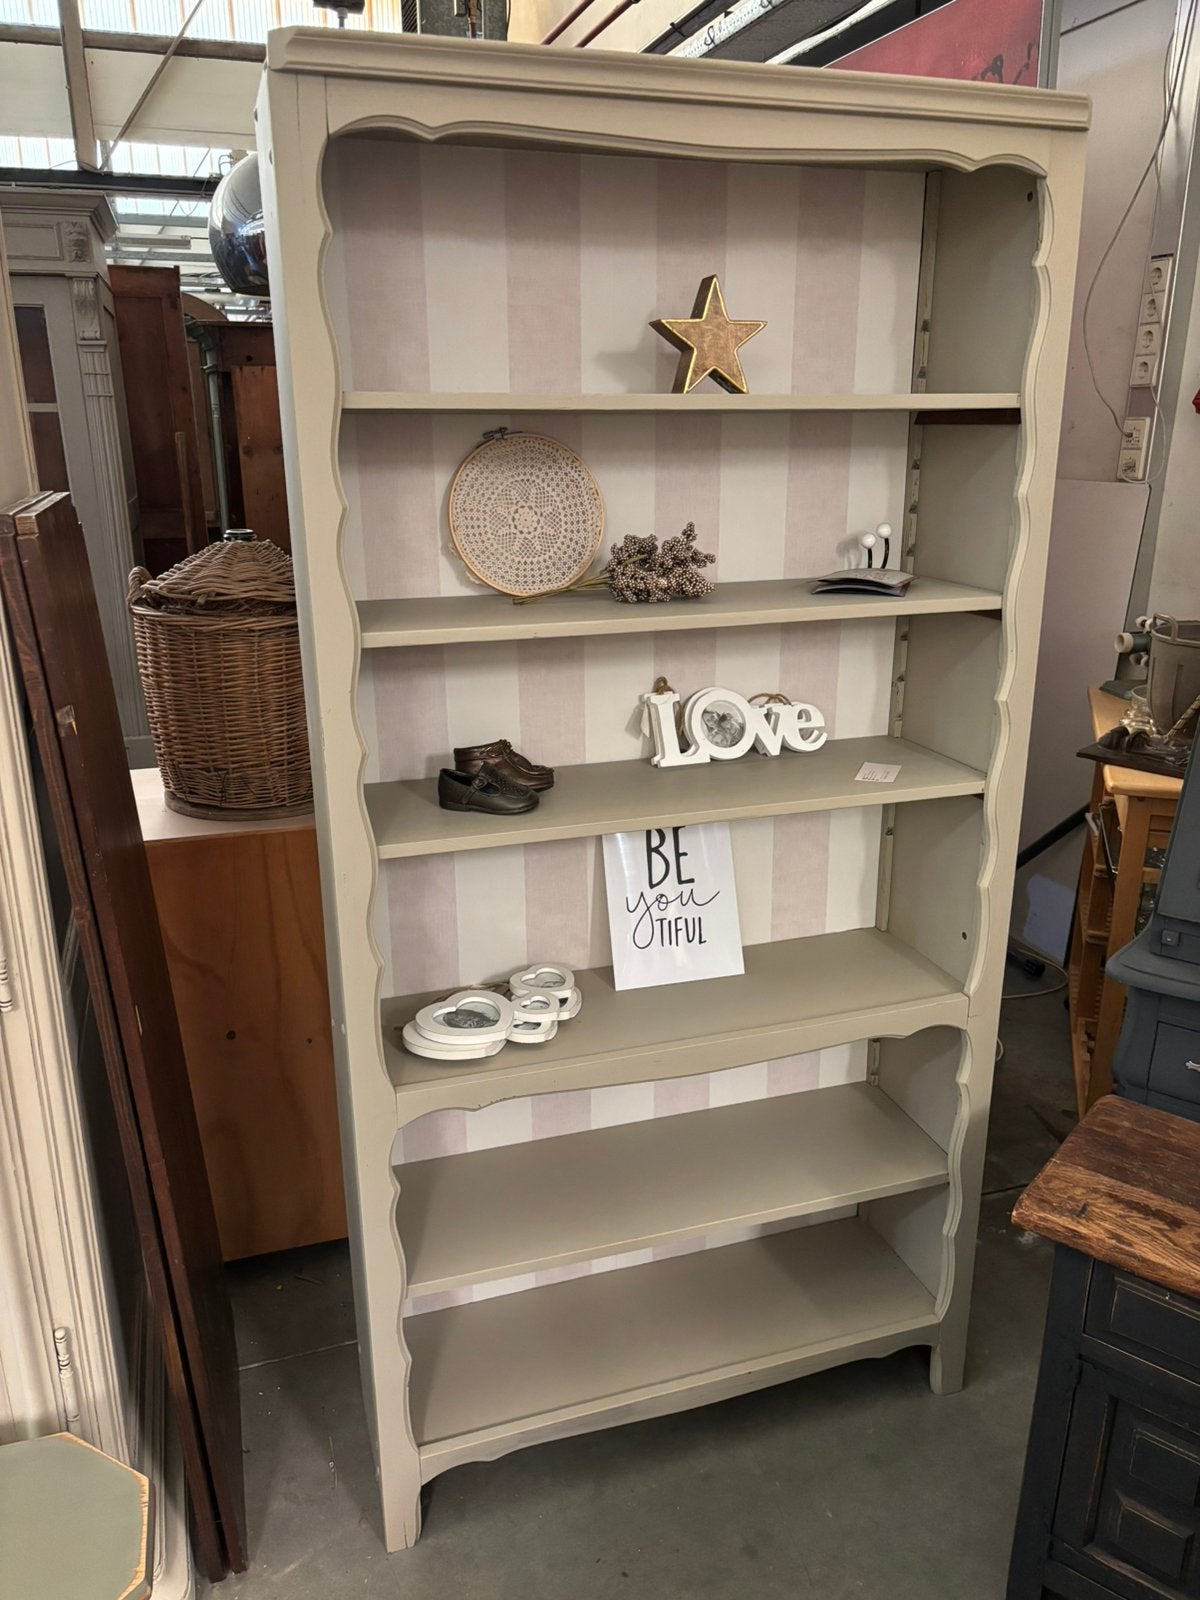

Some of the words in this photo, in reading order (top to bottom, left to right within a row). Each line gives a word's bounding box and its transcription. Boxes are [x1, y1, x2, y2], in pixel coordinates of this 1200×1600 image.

[645, 826, 695, 889] BE
[625, 889, 720, 949] you
[656, 916, 707, 946] TIFUL
